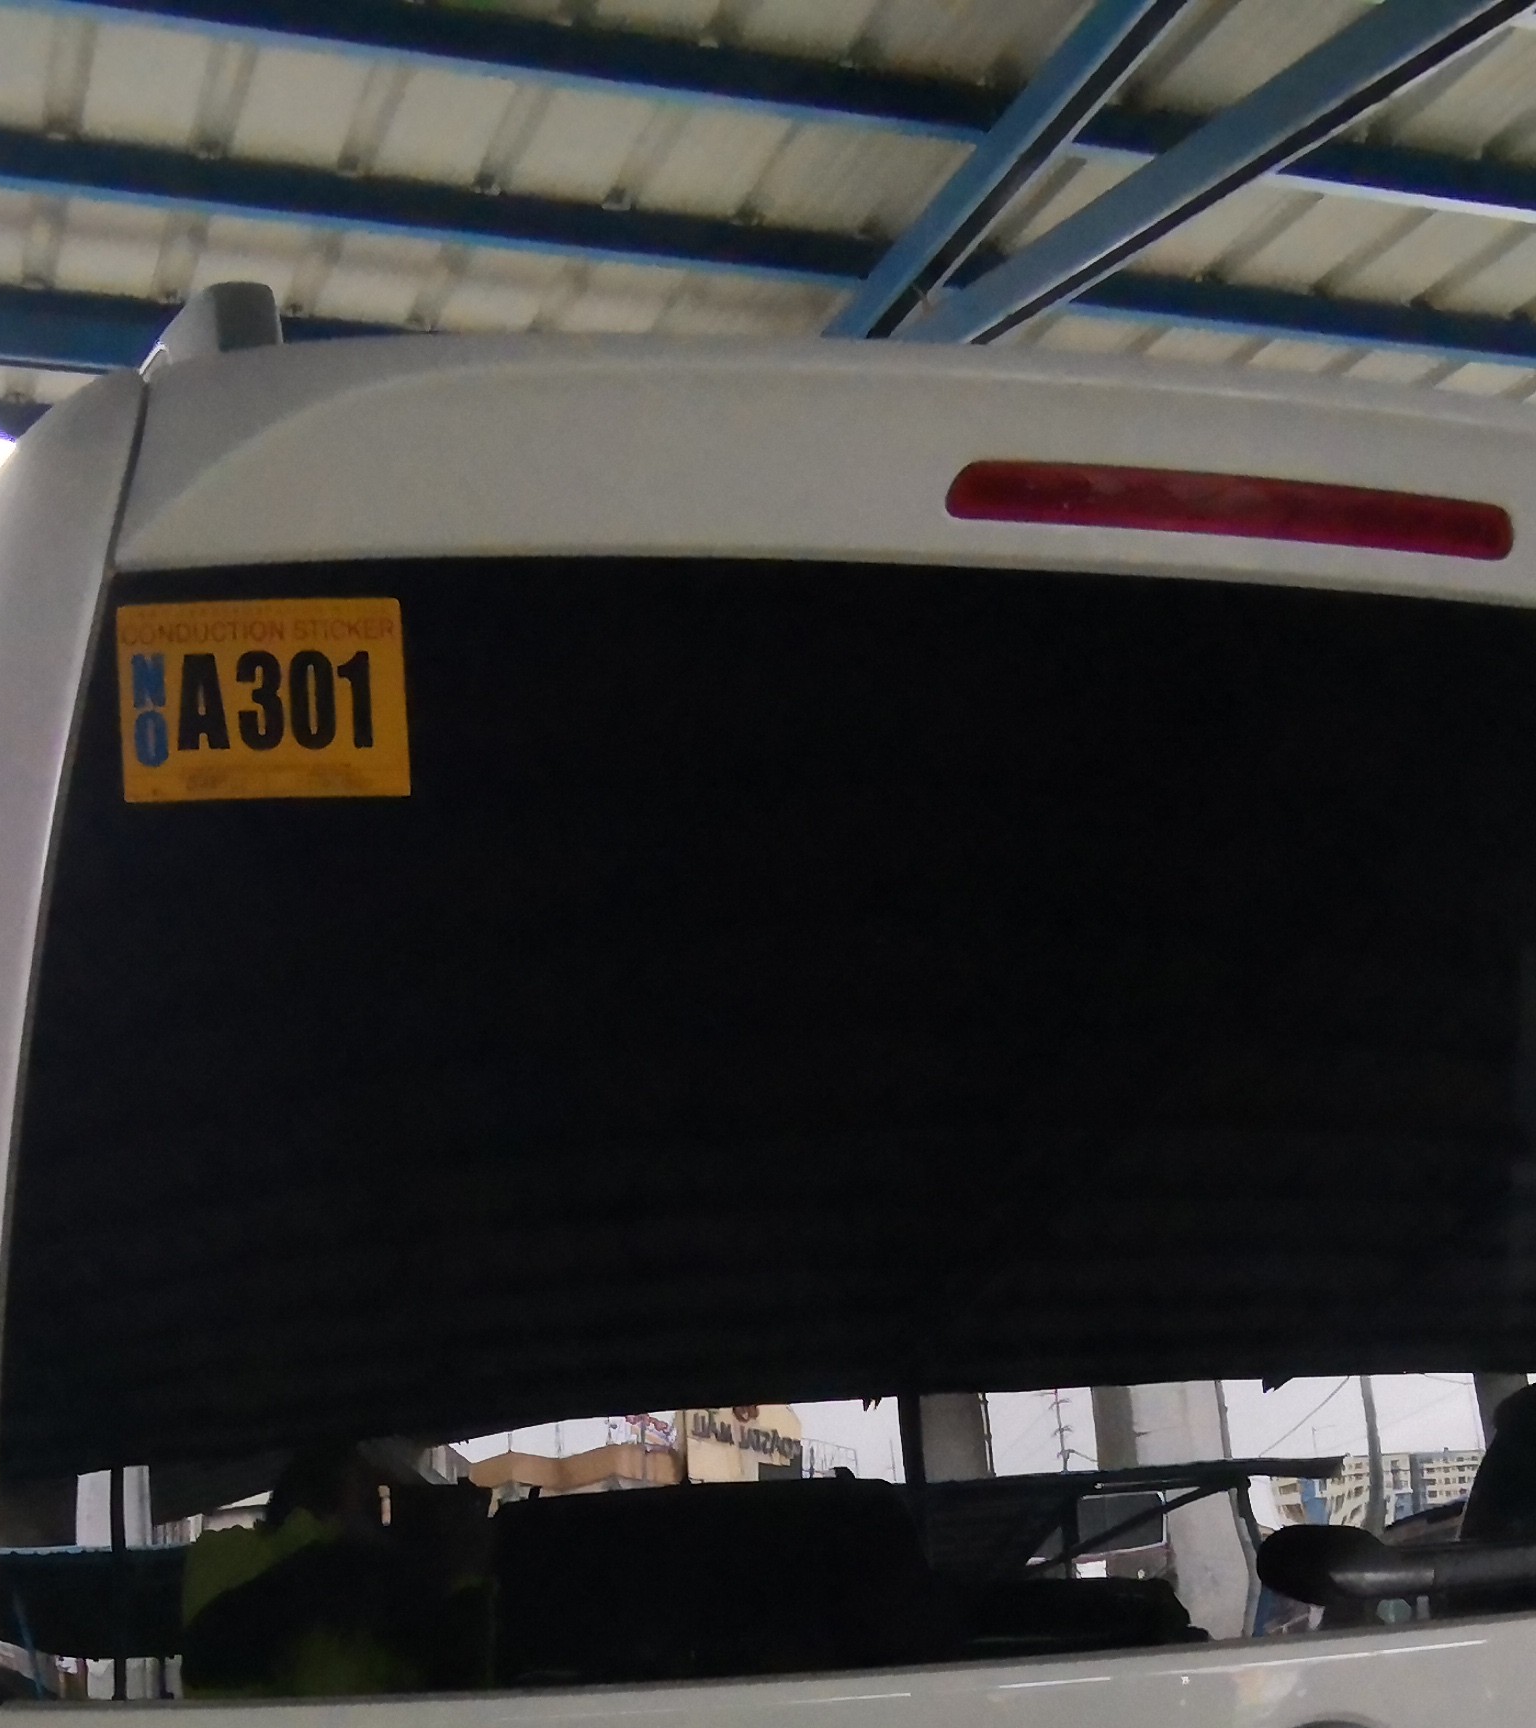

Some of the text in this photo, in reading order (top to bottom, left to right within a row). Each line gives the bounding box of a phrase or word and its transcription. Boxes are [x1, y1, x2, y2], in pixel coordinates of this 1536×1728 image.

[121, 617, 395, 646] CONDUCTION STICKER
[177, 650, 374, 751] A301
